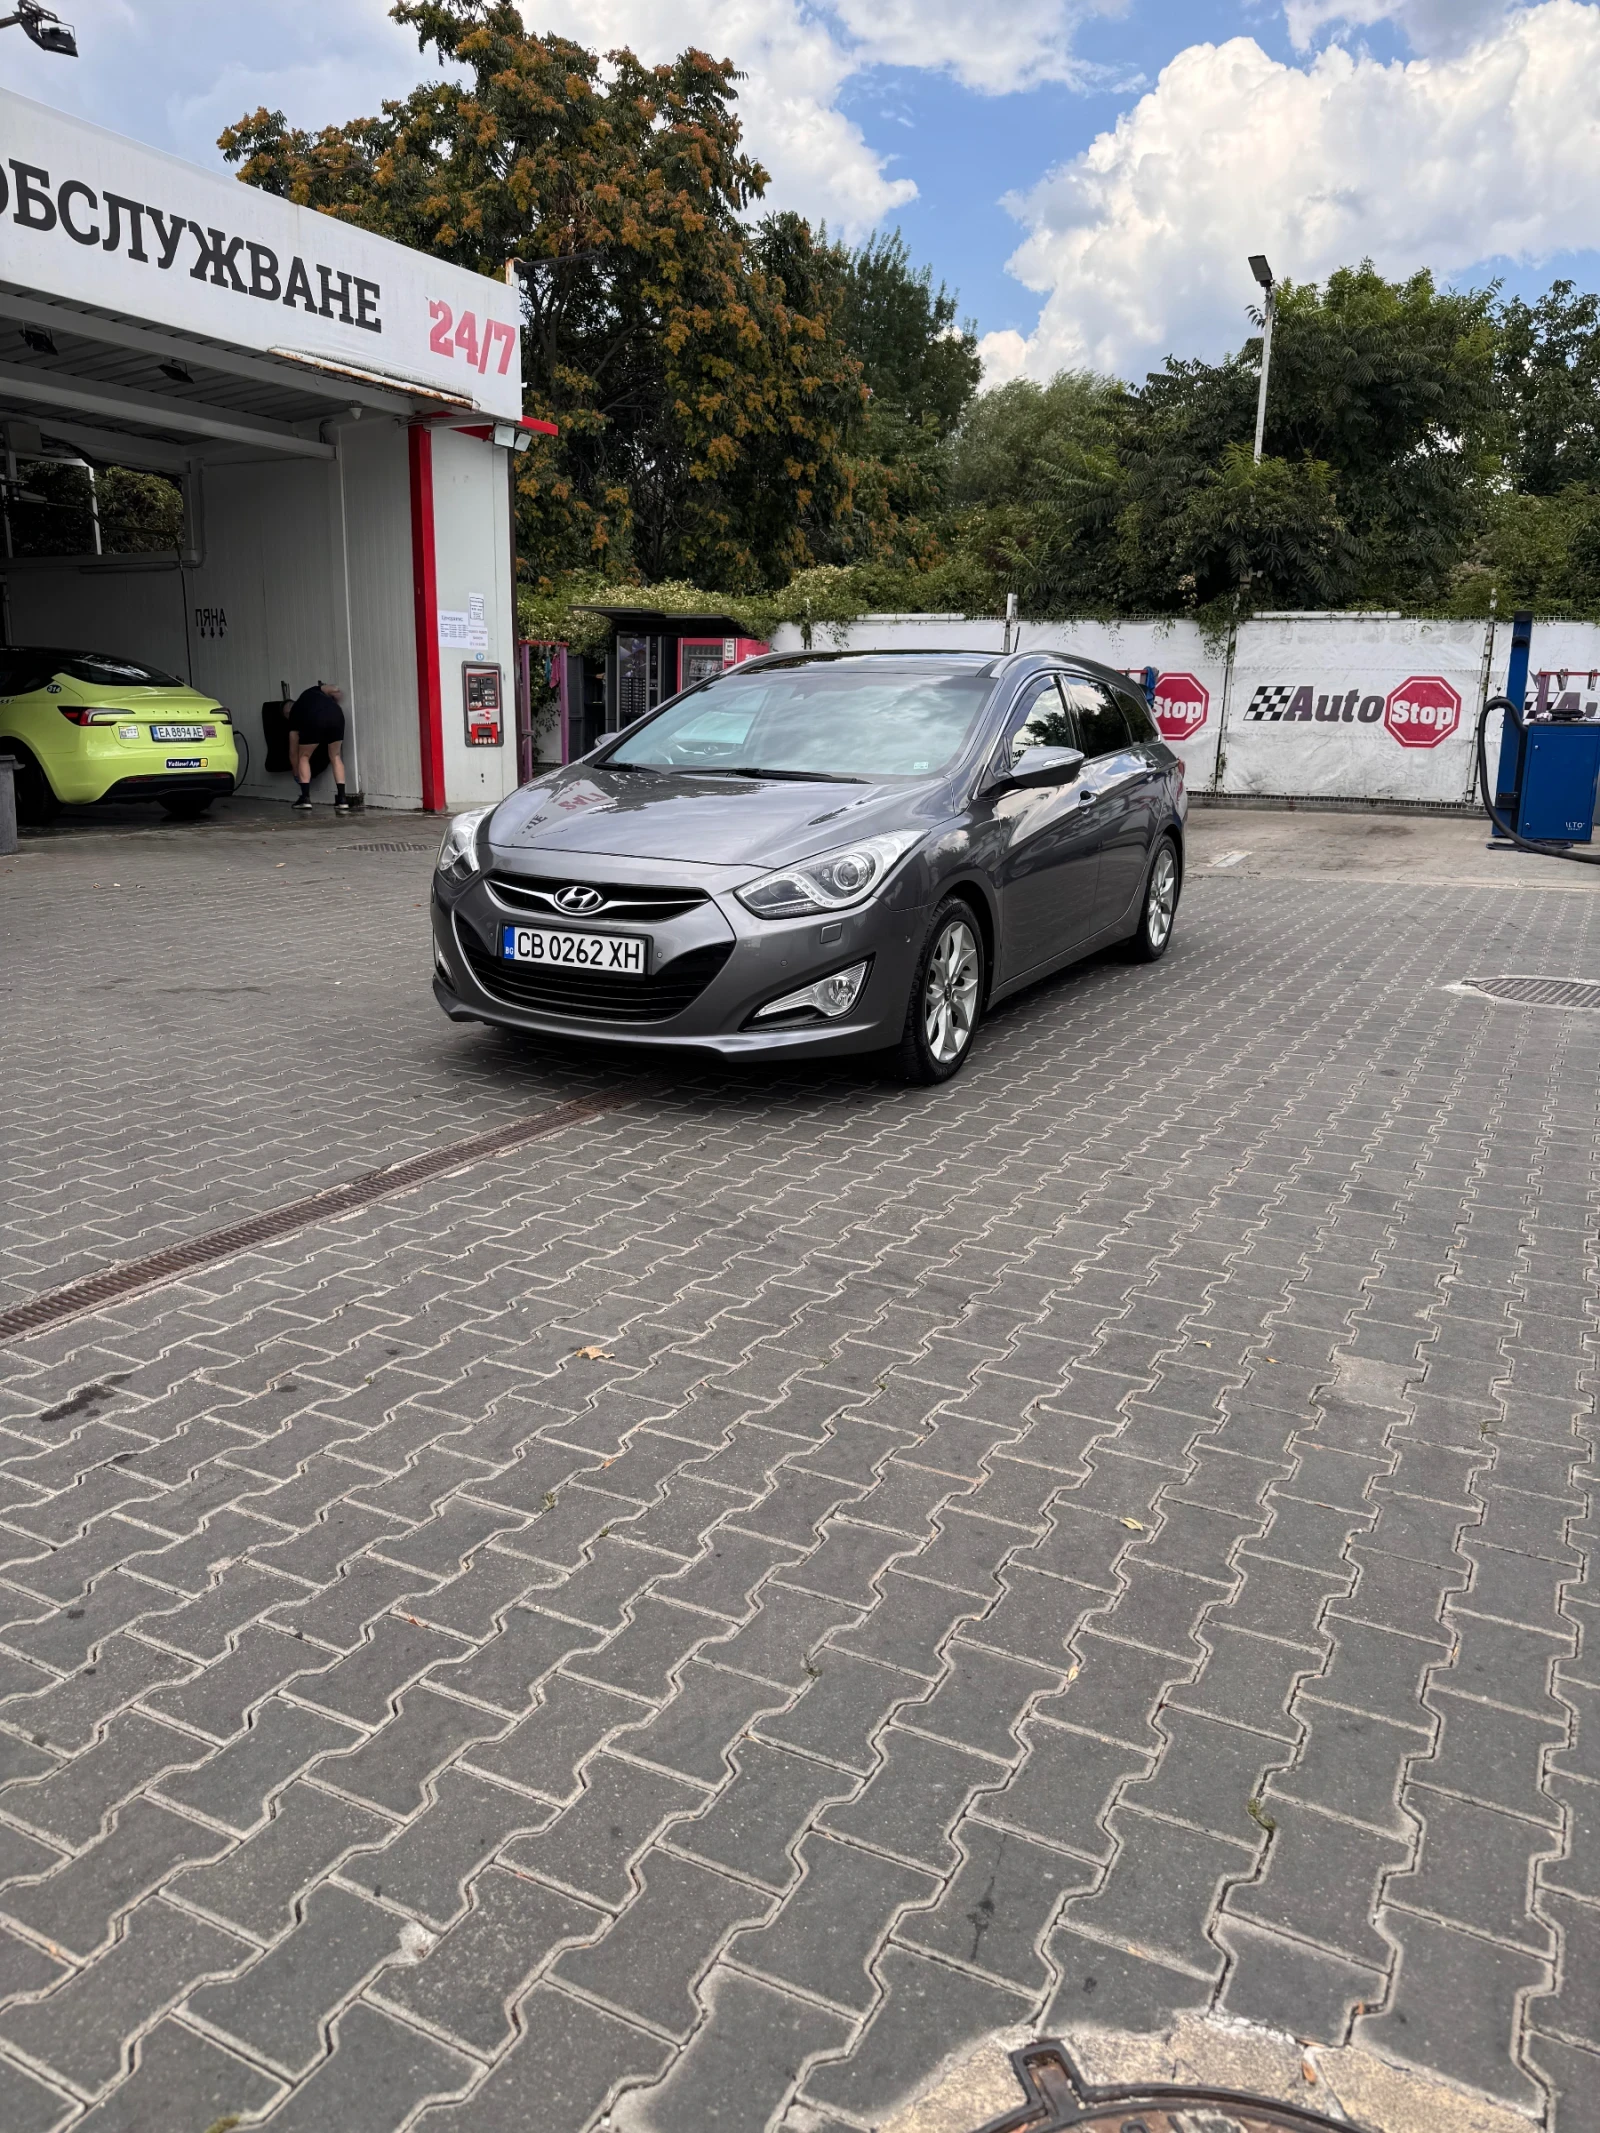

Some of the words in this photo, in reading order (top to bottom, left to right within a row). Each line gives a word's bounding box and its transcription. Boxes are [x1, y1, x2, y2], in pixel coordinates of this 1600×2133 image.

[0, 157, 382, 333] БСЛУЖВАНЕ
[429, 299, 516, 376] 24/7
[195, 608, 227, 627] ПЯНА
[1152, 695, 1202, 723] Stop
[1282, 685, 1386, 723] Auto
[1391, 700, 1454, 731] Stop
[172, 726, 192, 738] 8894
[505, 946, 514, 955] BG
[549, 935, 603, 967] 0262
